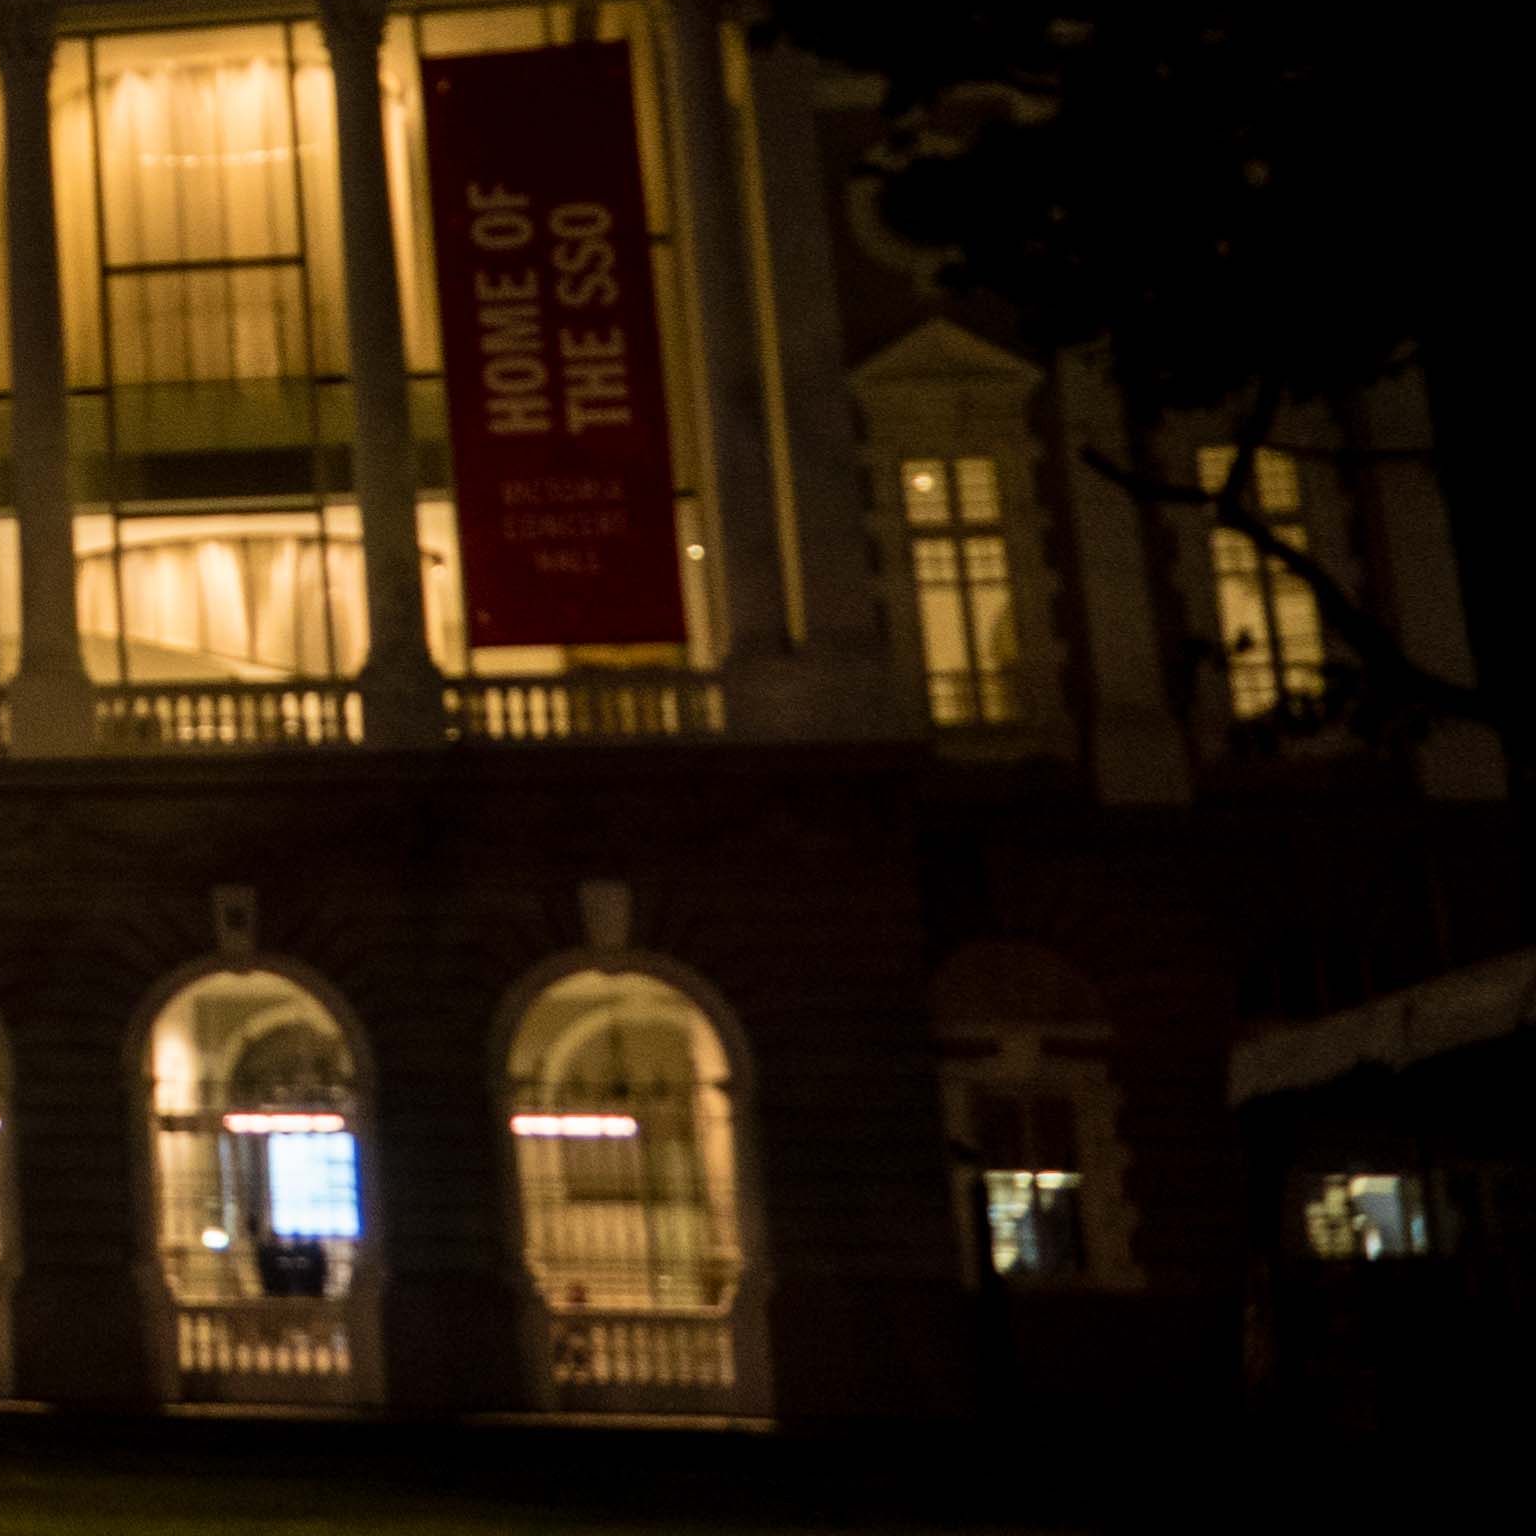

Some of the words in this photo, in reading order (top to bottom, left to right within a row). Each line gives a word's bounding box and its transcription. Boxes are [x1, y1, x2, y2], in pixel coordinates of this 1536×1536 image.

[464, 177, 536, 254] OF
[545, 199, 622, 311] SSO
[473, 263, 554, 437] HOME
[558, 320, 634, 438] THE
